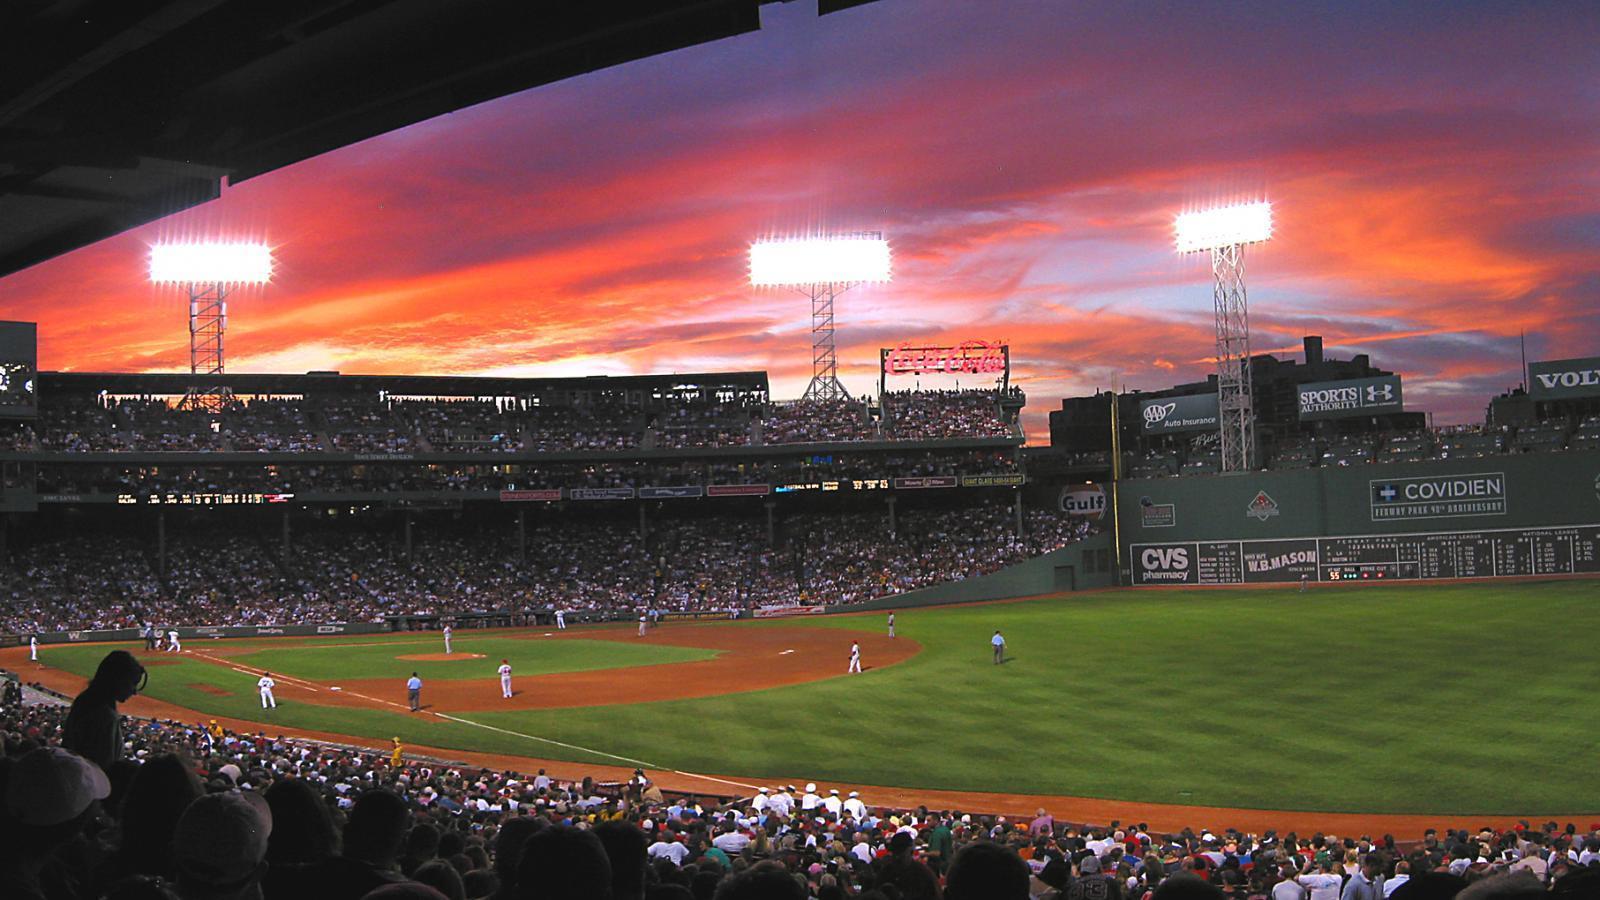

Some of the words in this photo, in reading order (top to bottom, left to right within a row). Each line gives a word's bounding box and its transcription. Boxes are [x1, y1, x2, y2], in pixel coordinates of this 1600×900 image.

[1536, 369, 1600, 388] VOL
[1300, 387, 1358, 405] SPORTS
[1145, 406, 1163, 421] AAA
[1301, 401, 1359, 412] AUTHORITY
[1182, 417, 1216, 426] Insurance
[1405, 479, 1500, 499] COVIDIEN
[1062, 496, 1103, 510] Gulf
[1375, 507, 1405, 516] FENWAY
[1408, 506, 1427, 514] PARK
[1448, 502, 1501, 513] ANNIVERSARY
[1142, 548, 1188, 570] CVS
[1143, 570, 1188, 581] pharmacy
[1330, 572, 1340, 580] 55
